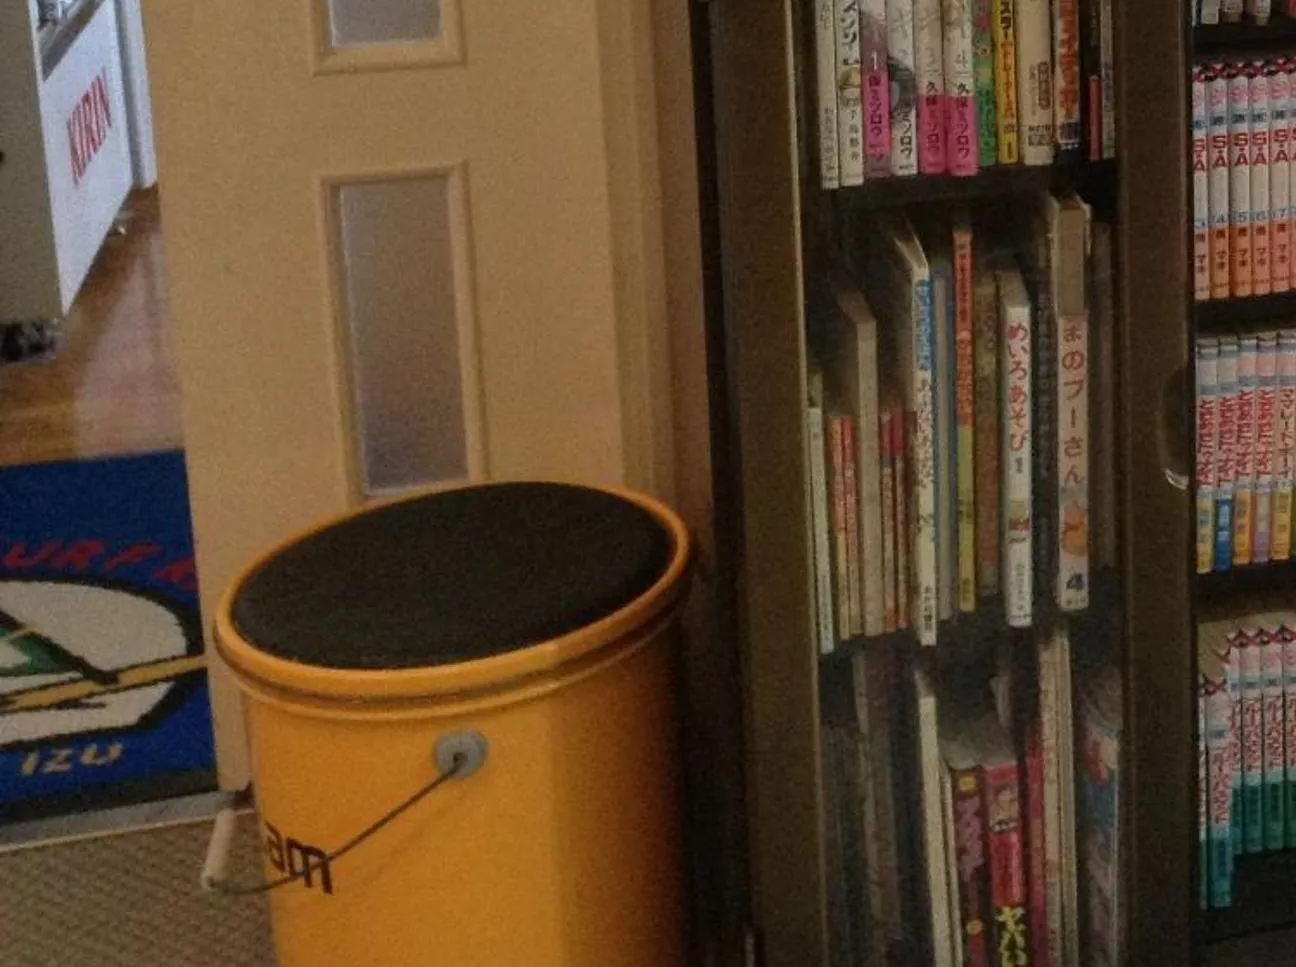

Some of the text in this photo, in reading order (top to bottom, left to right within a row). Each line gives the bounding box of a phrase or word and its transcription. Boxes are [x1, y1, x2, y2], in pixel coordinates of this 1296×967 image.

[1009, 322, 1030, 452] めいろあそび
[1062, 324, 1087, 484] まのプーさん
[19, 742, 125, 777] IZU
